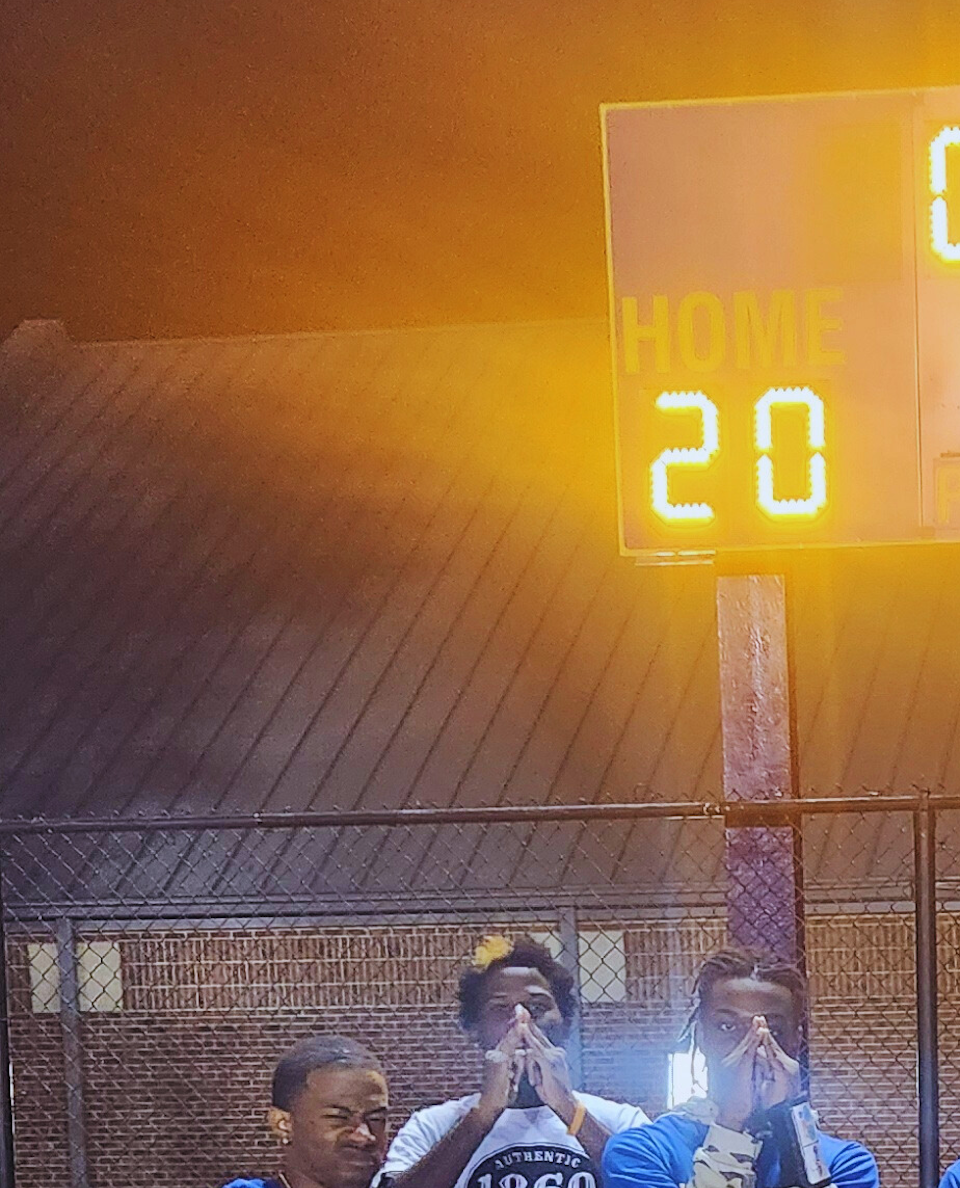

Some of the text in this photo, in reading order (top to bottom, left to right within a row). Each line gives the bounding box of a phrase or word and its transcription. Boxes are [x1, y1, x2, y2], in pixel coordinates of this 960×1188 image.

[621, 288, 847, 375] HOME
[650, 386, 827, 523] 20
[495, 1151, 581, 1169] AUTHENTIC
